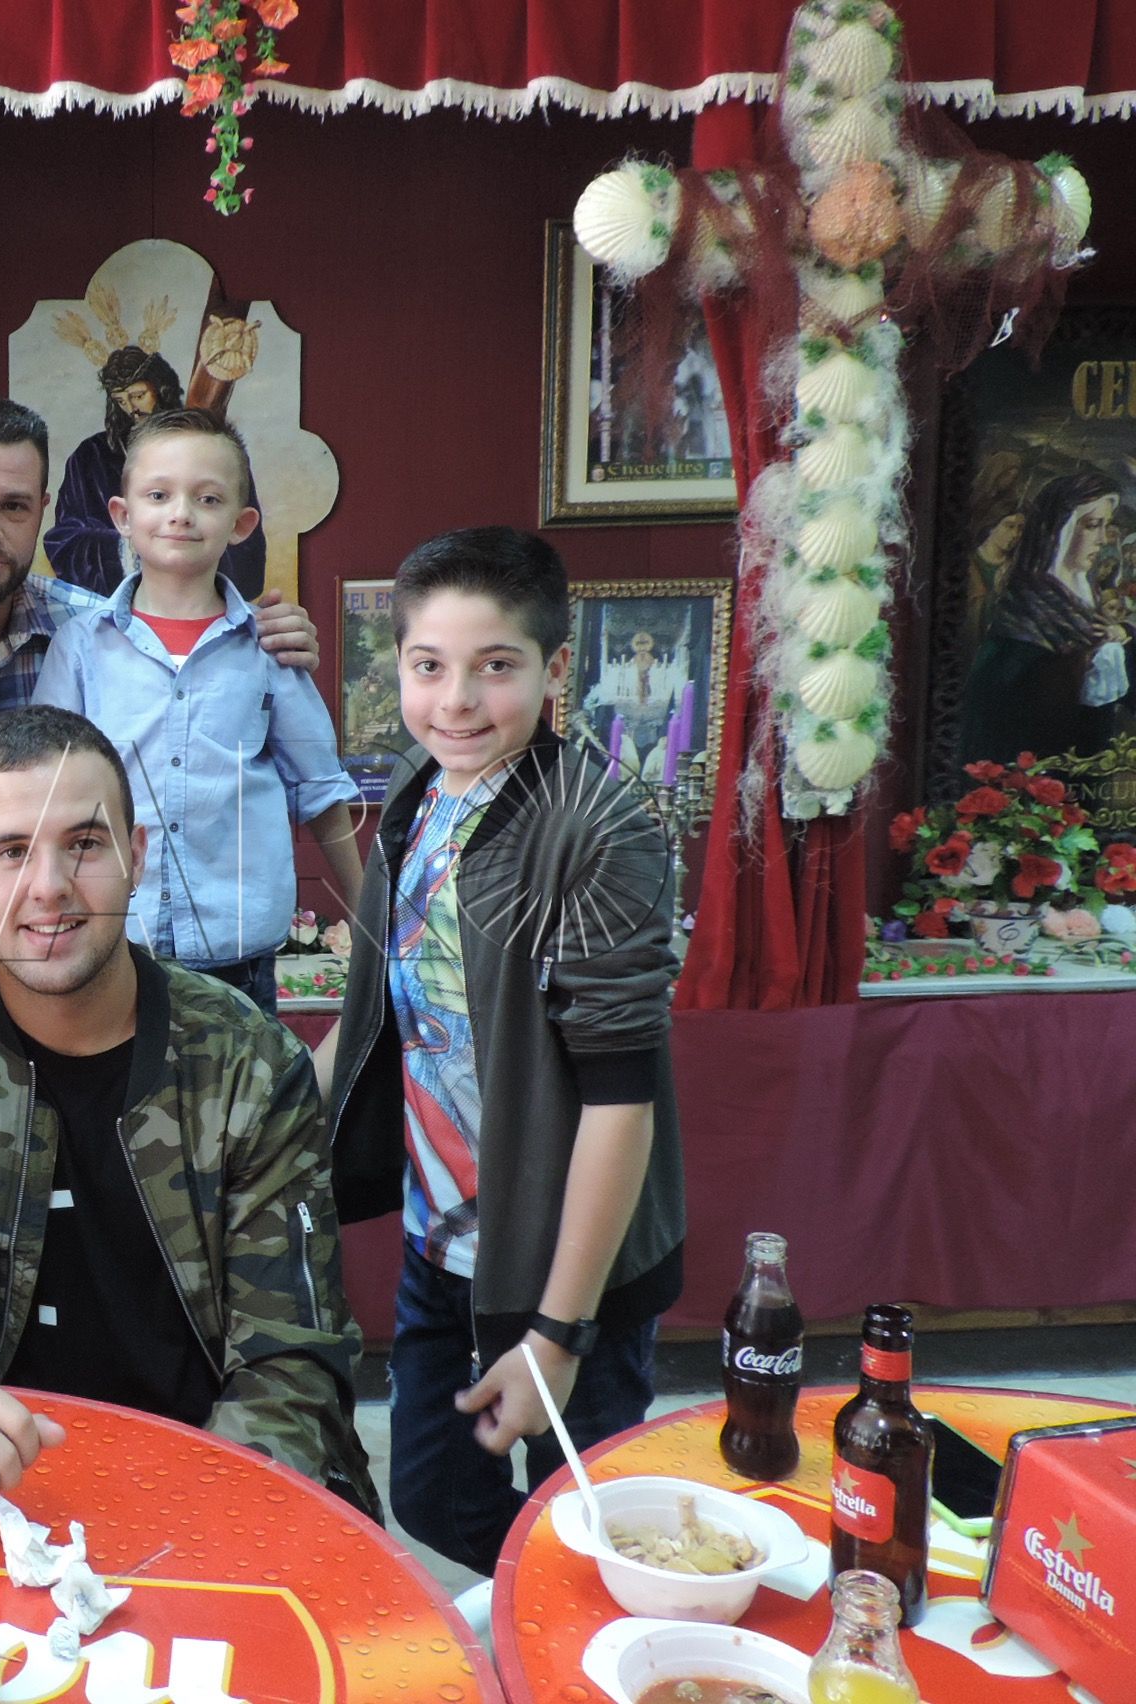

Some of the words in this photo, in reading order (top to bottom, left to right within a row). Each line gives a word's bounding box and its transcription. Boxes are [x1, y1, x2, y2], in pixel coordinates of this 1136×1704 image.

[1065, 781, 1136, 803] ENCU
[1024, 1526, 1115, 1617] Estrella
[1046, 1568, 1086, 1612] Damm
